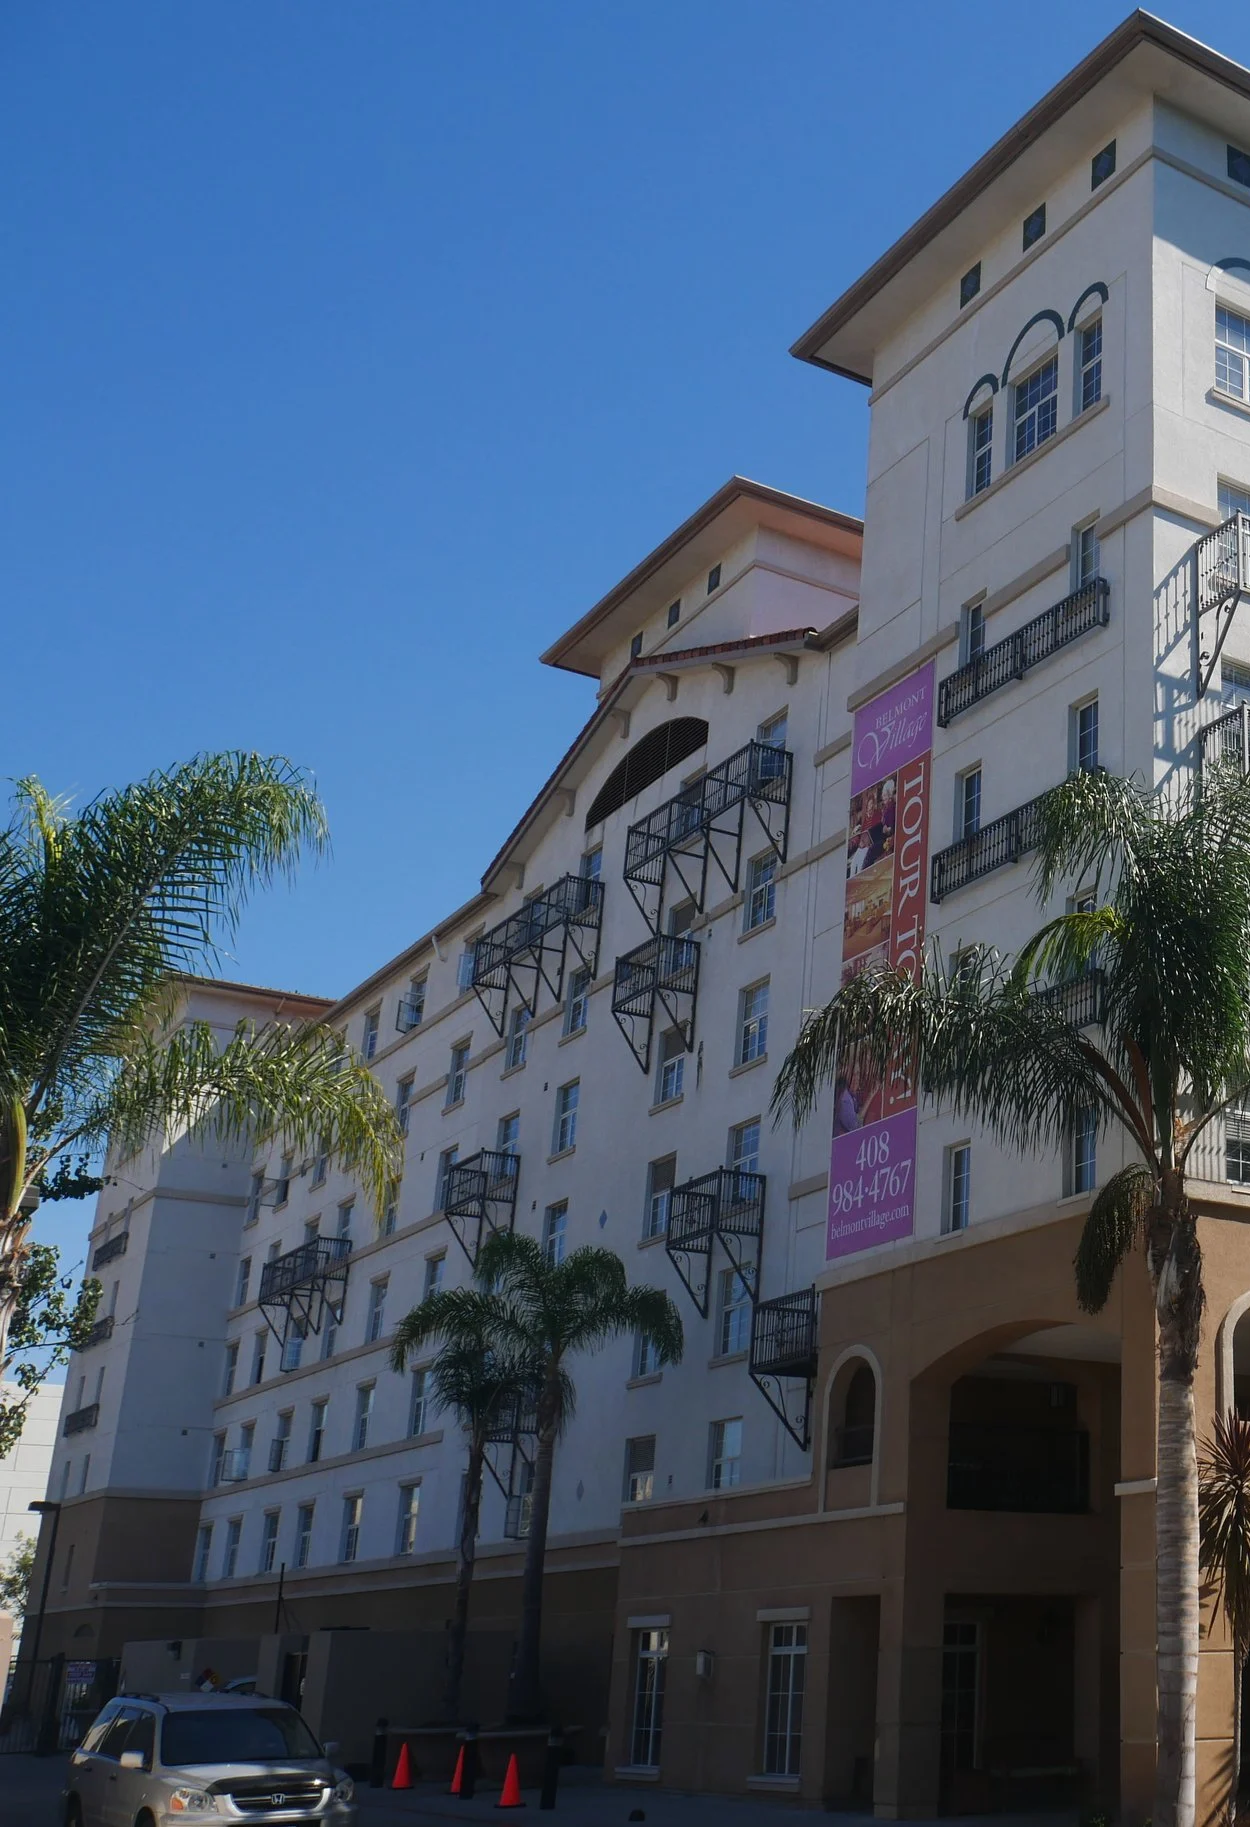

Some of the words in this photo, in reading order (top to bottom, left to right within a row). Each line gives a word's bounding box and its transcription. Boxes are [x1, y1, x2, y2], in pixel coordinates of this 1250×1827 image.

[876, 686, 927, 729] BELMONT
[857, 711, 928, 769] Village
[897, 761, 925, 917] TOUR
[855, 1131, 890, 1171] 408
[831, 1205, 910, 1240] belmontvillage.com
